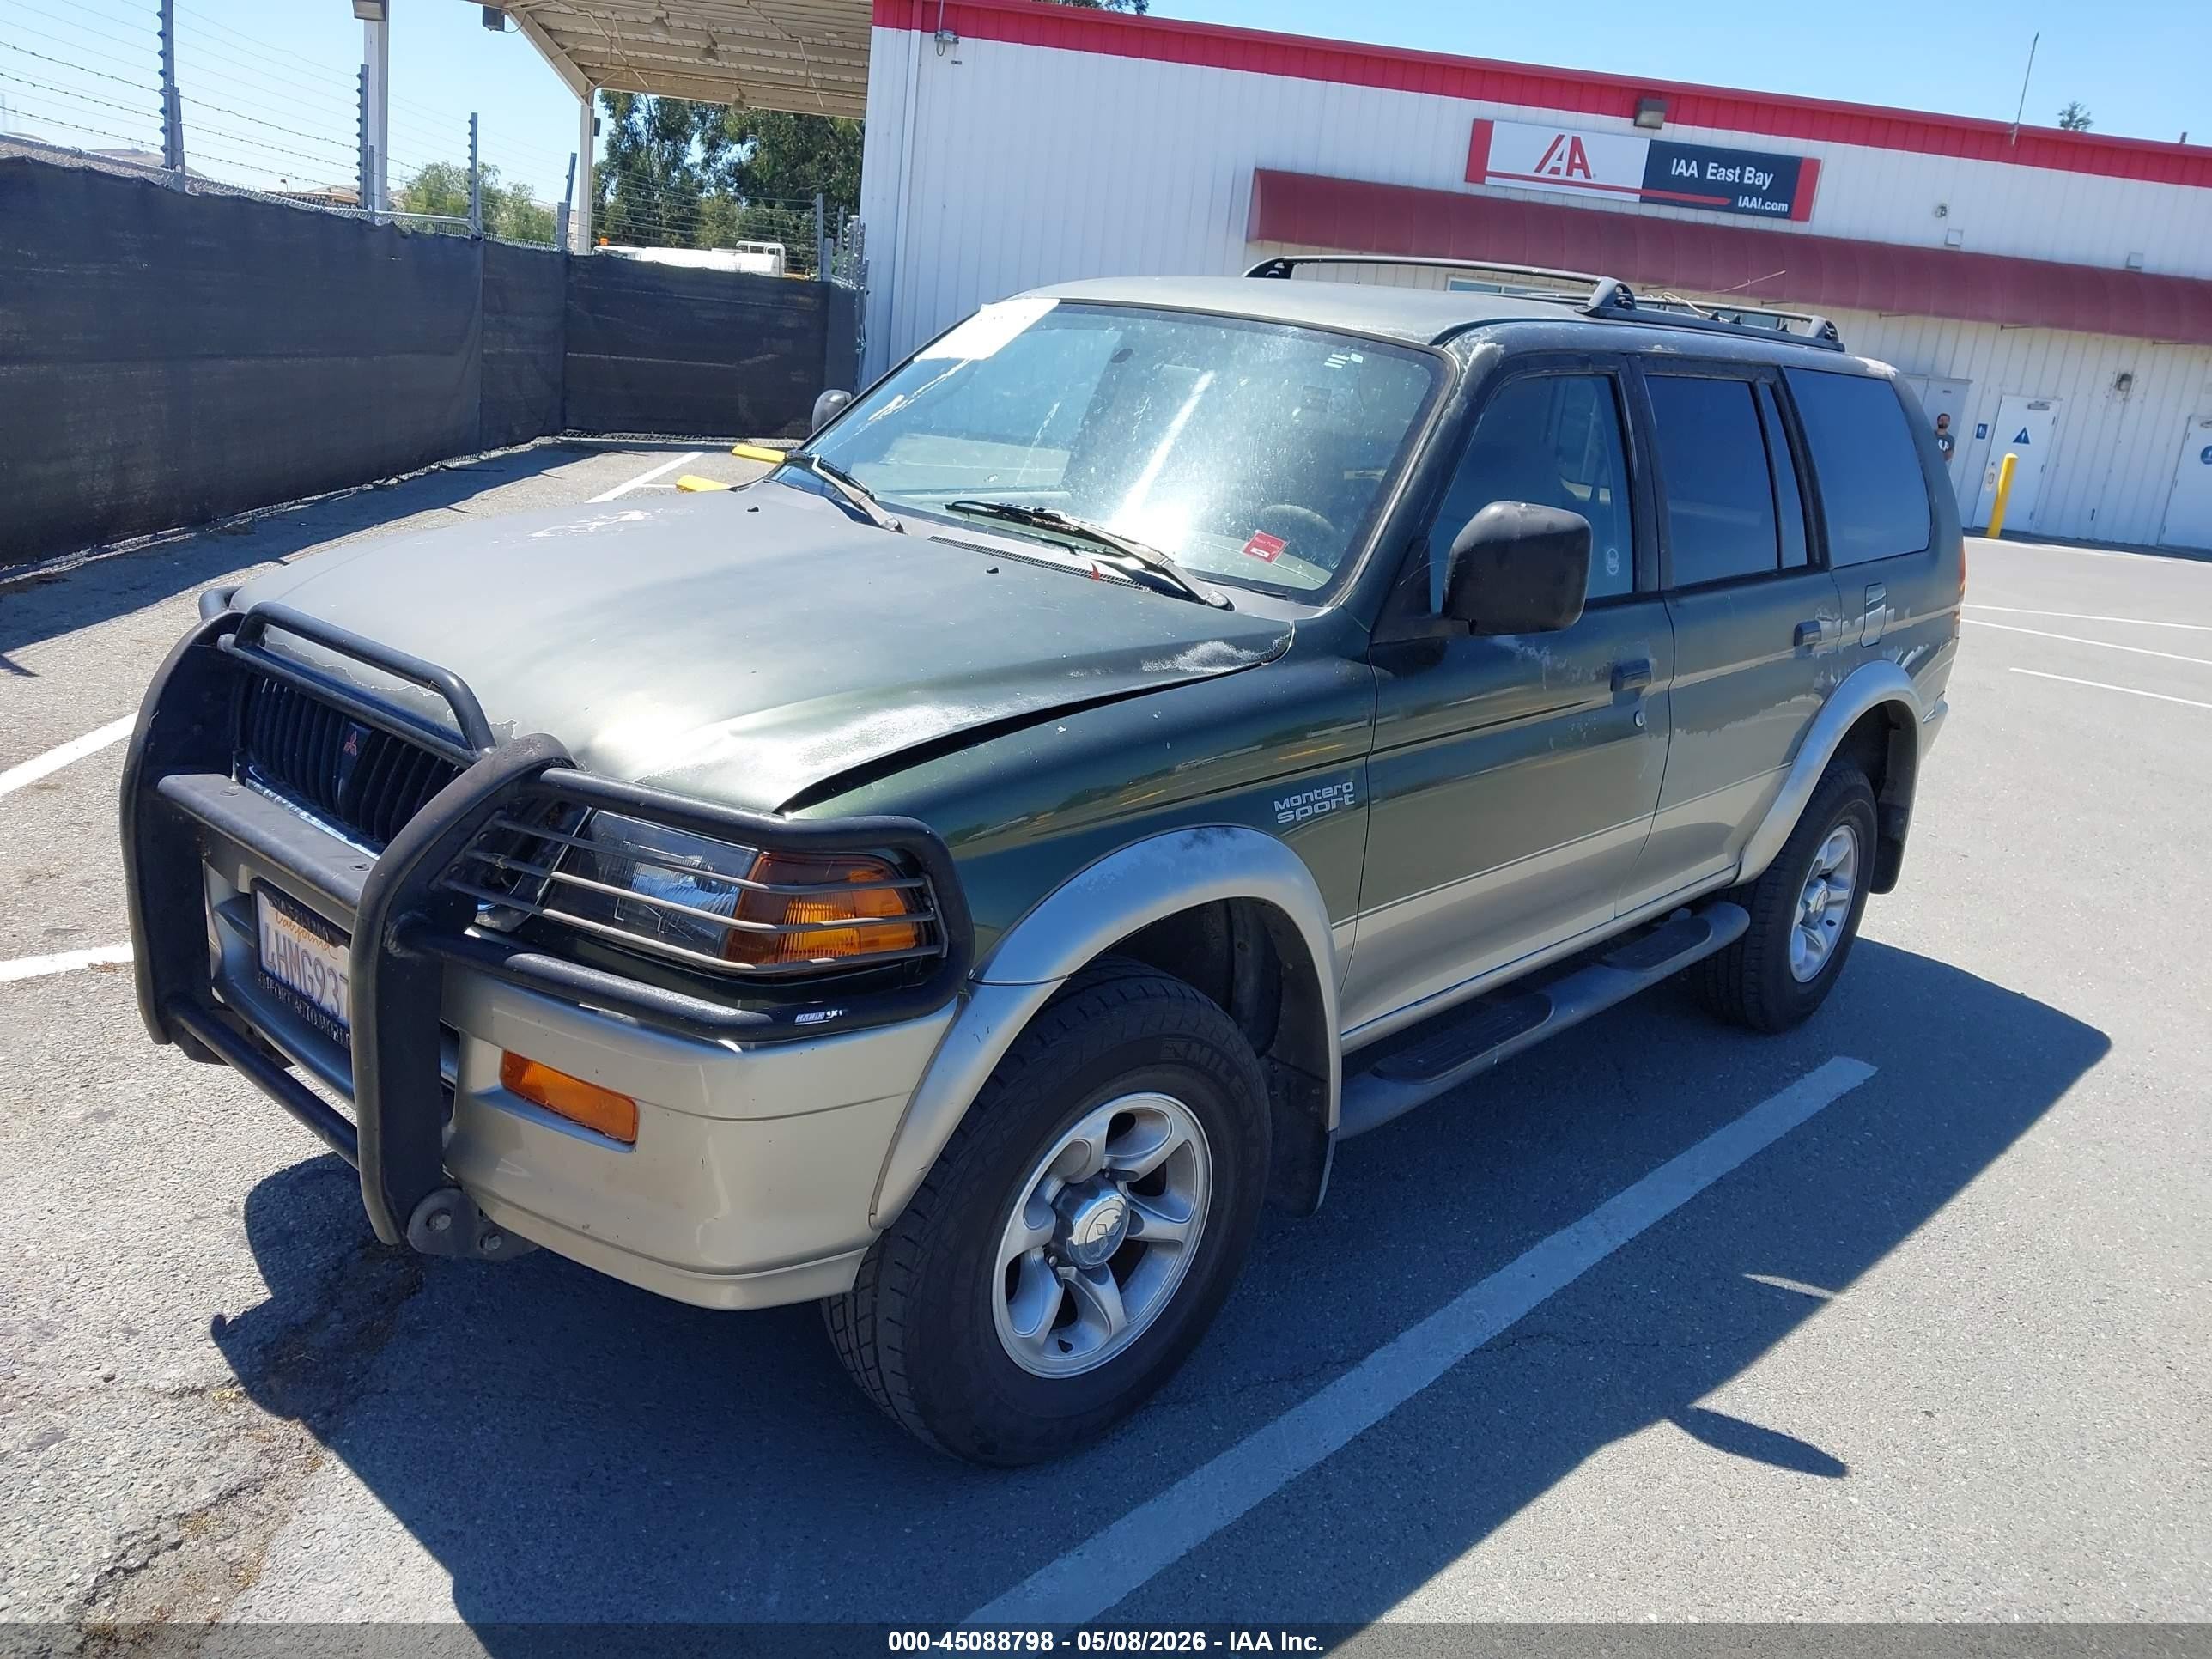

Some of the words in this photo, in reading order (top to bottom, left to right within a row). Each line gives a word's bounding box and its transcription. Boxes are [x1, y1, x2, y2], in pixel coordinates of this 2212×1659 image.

[1671, 157, 1698, 178] IAA
[1706, 162, 1741, 183] East
[1743, 167, 1774, 191] Bay
[1737, 195, 1789, 212] IAAI.com
[1273, 781, 1354, 811] Montero
